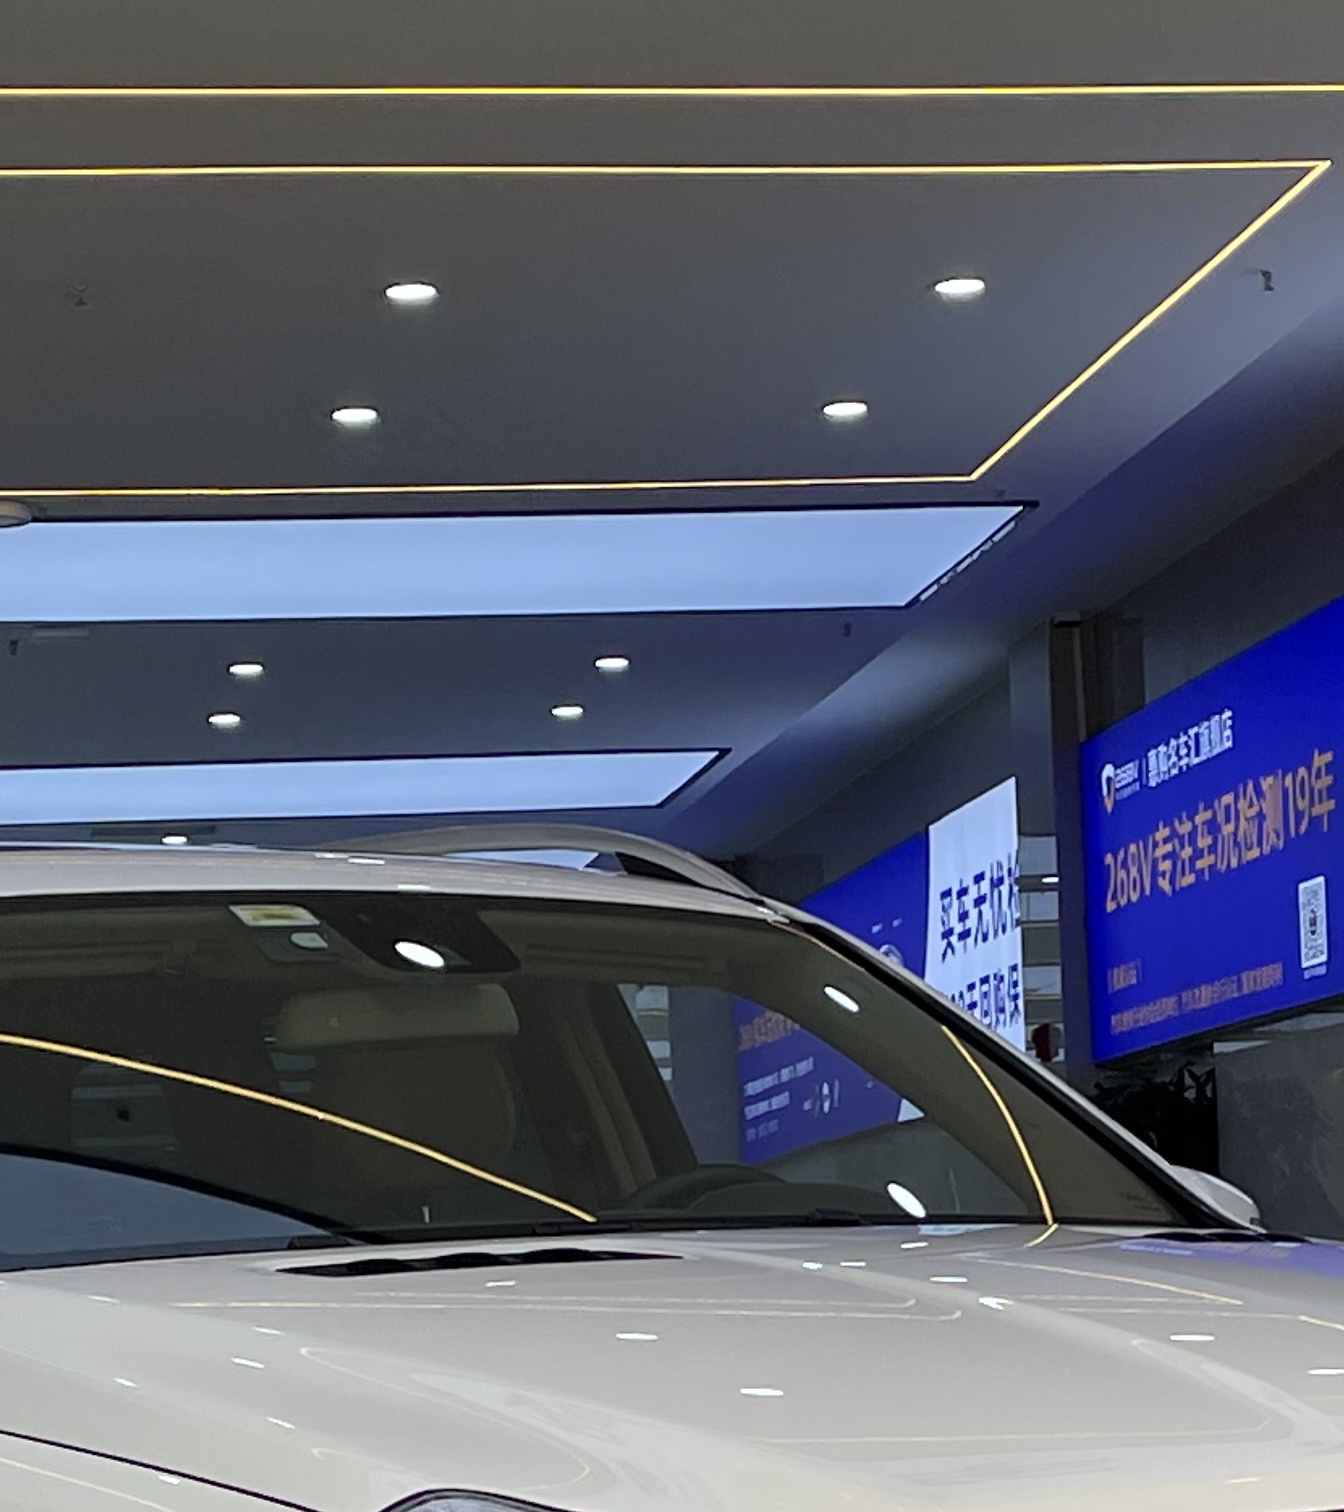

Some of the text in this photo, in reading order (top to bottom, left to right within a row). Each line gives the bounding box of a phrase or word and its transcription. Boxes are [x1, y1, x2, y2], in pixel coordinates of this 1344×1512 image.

[1105, 748, 1335, 913] 268V专注车况检测19年
